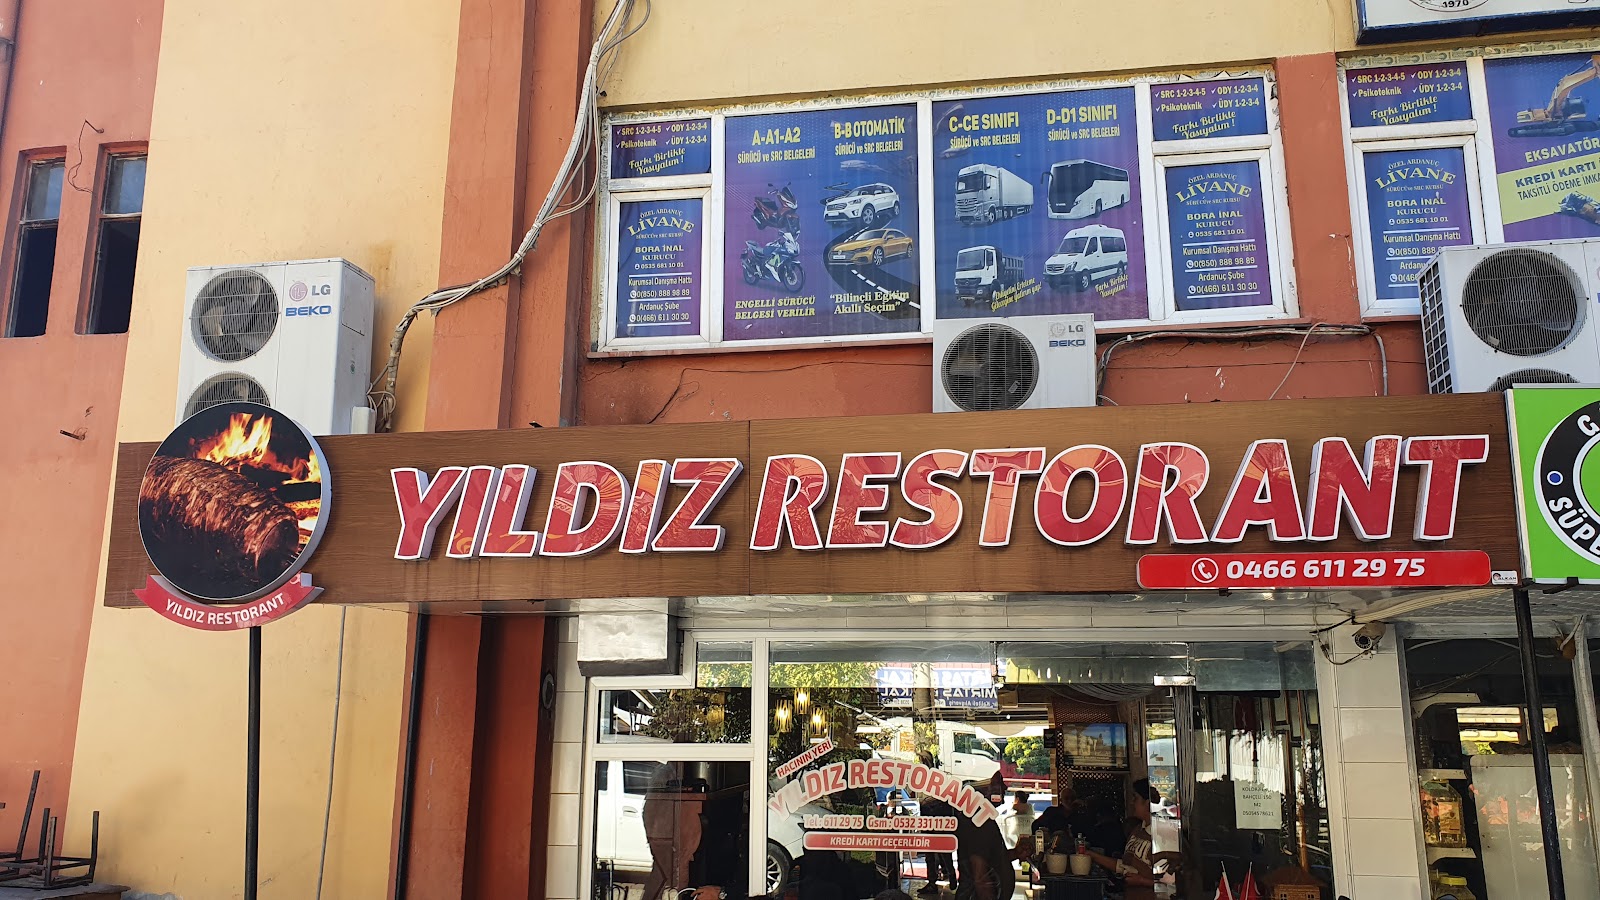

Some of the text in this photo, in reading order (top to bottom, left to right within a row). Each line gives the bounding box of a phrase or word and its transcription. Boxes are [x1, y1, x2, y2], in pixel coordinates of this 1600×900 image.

[1442, 0, 1469, 8] 1970
[1357, 72, 1406, 84] SRC 1-2-3-4-5
[1435, 68, 1462, 78] 1-2-3-4
[1160, 87, 1206, 99] SRC 1-2-3-4-5
[1233, 84, 1259, 94] 1-2-3-4
[1358, 86, 1402, 98] Psikoteknik
[1418, 82, 1463, 94] ÜDY 1-2-3-4
[1161, 101, 1203, 112] Psikoteknik
[1218, 97, 1260, 109] ÜDY 1-2-3-4
[1399, 95, 1438, 112] Birlikte
[1046, 107, 1077, 125] D-D1
[1199, 110, 1236, 126] Birlikte
[685, 122, 708, 132] 1-2-3-4
[833, 115, 906, 139] B-B OTOMATİK
[948, 114, 980, 133] C-CE
[621, 125, 662, 136] SRC 1-2-3-4-5
[751, 126, 801, 146] A-A1-A2
[1047, 123, 1121, 142] SÜRÜCÜ ve SRC BELGELERİ
[620, 138, 657, 149] Psikoteknik
[685, 134, 707, 144] 1-2-3-4
[949, 131, 1021, 149] SÜRÜCÜ ve SRC BELGELERİ
[834, 137, 904, 156] SÜRÜCÜ ve SRC BELGELERİ
[653, 147, 686, 162] Birlikte
[737, 145, 816, 164] SÜRÜCÜ ve SRC BELGELERİ
[1374, 167, 1457, 190] LİVANE
[1515, 160, 1597, 188] KREDİ KARTI
[1175, 181, 1252, 203] LİVANE
[1517, 182, 1551, 201] TAKSİTLİ
[1552, 177, 1582, 193] ÖDEME
[1387, 197, 1447, 208] BORA İNAL
[1186, 210, 1244, 221] BORA İNAL
[1396, 207, 1437, 216] KURUCU
[627, 216, 695, 237] LİVANE
[1195, 220, 1235, 229] KURUCU
[1383, 231, 1461, 243] Kurumsal Danışma Hattı
[635, 245, 660, 254] BORA
[1182, 243, 1257, 256] Kurumsal Danışma Hattı
[642, 253, 676, 261] KURUCU
[628, 277, 654, 287] Kurumsal
[1198, 270, 1245, 282] Ardanuç Şube
[311, 284, 331, 296] LG
[1196, 281, 1258, 294] 0(466) 611 30 30
[639, 301, 680, 311] Ardanuç Şube
[734, 294, 816, 309] ENGELLİ SÜRÜCÜ
[285, 305, 332, 317] BEKO
[734, 307, 816, 320] BELGESİ VERİLİR
[1068, 324, 1084, 333] LG
[1048, 339, 1086, 348] BEKO
[390, 434, 1490, 561] YILDIZ RESTORANT
[1226, 557, 1426, 580] 0466 611 29 75
[165, 592, 286, 625] YILDIZ RESTORANT
[770, 761, 997, 825] YDIZ RESTORANT
[824, 816, 840, 827] 611
[840, 816, 850, 827] 29
[852, 816, 863, 827] 75
[893, 817, 916, 828] 0532
[917, 818, 932, 829] 331
[934, 818, 943, 829] 11
[944, 818, 956, 829] 29
[830, 835, 930, 849] KREDİ KARTI GEÇERLİDİR
